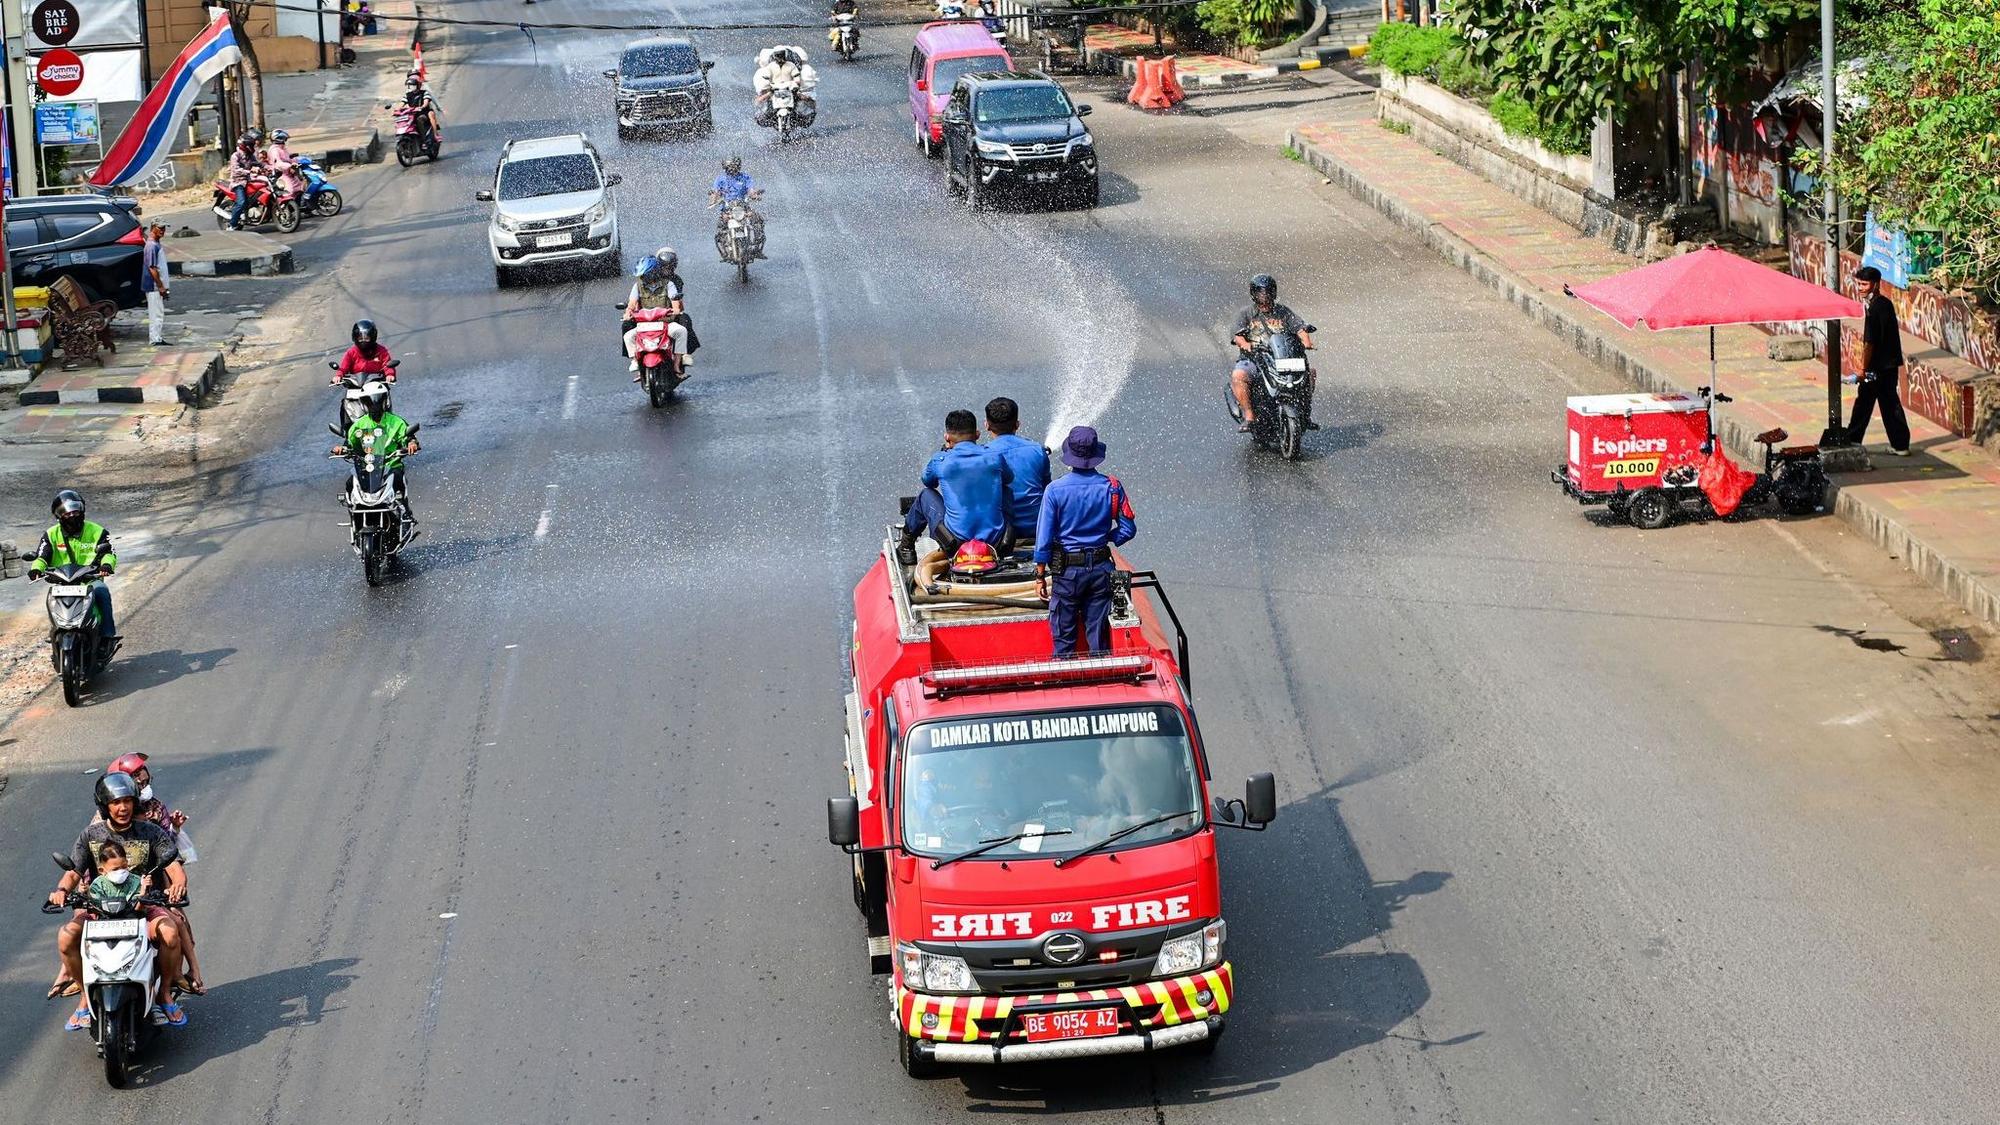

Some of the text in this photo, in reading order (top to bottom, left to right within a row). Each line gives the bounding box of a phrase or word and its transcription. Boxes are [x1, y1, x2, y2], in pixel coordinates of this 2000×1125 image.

[44, 9, 66, 19] SAY
[46, 18, 68, 27] BRE
[46, 27, 62, 36] AD
[1593, 434, 1668, 458] kopiers
[1609, 462, 1654, 474] 10.000
[931, 711, 1159, 748] DAMKAR KOTA BANDAR LAMPUNG
[1050, 912, 1073, 924] 022
[1091, 895, 1191, 929] FIRE
[1028, 1011, 1115, 1033] BE 9054 AZ
